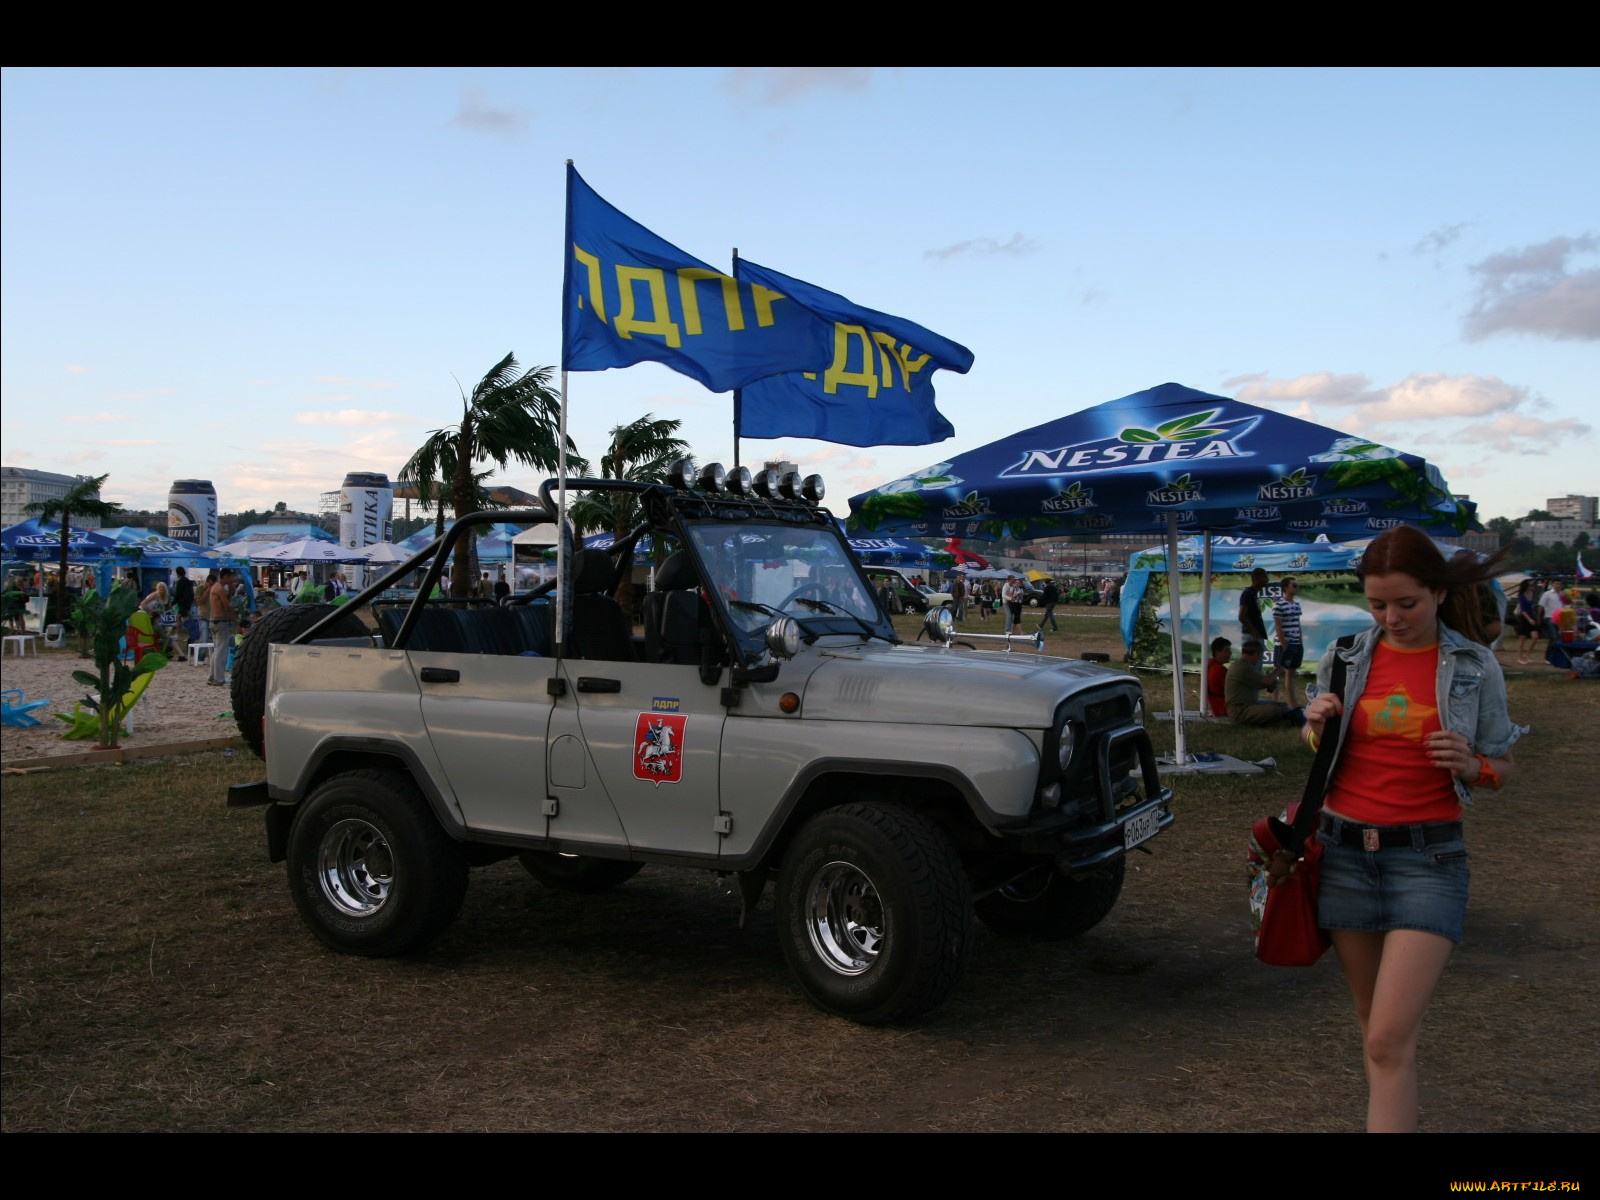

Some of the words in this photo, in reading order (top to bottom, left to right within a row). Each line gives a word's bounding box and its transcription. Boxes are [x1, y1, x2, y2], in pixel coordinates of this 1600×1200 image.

[1020, 440, 1237, 472] NESTEA
[1149, 490, 1201, 503] NESTEA
[1261, 486, 1314, 500] NESTEA
[1042, 497, 1095, 511] NESTEA
[943, 506, 991, 517] NESTEA
[20, 536, 89, 544] NESEA
[848, 538, 897, 549] ESTEA
[653, 699, 679, 709] ЛДПР
